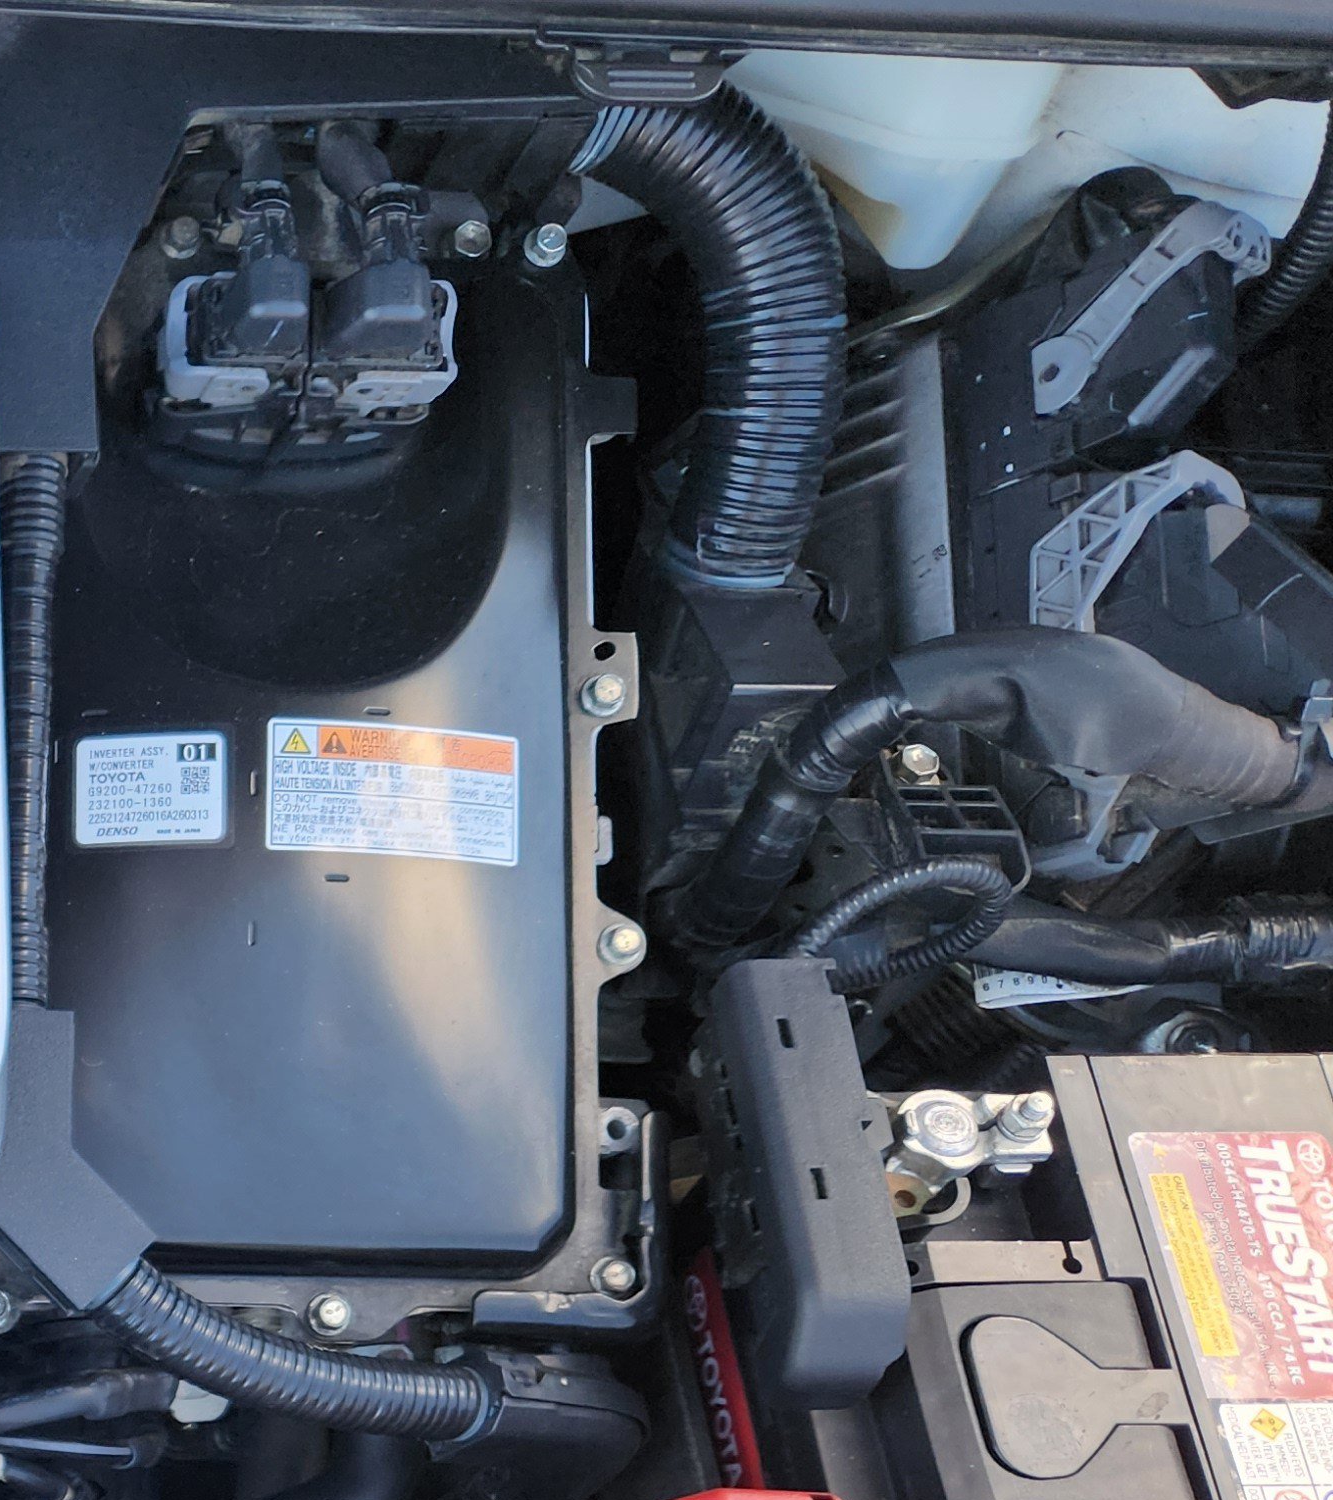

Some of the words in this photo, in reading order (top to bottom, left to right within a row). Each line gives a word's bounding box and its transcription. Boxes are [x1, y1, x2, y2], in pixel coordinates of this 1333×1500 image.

[89, 748, 134, 759] INVERTER
[140, 747, 169, 756] ASSY.
[183, 744, 208, 761] 01
[89, 760, 154, 771] W/CONVERTER
[274, 760, 293, 774] HIGH
[297, 761, 330, 775] VOLTAGE
[333, 762, 357, 777] INSIDE
[89, 772, 146, 784] TOYOTA
[274, 778, 299, 789] HAUTE
[301, 778, 332, 790] TENSION
[88, 783, 172, 797] G9200-47260
[275, 793, 290, 802] DO
[296, 794, 318, 802] NOT
[88, 797, 172, 811] 232100-1360
[96, 827, 138, 836] DENSO
[275, 823, 289, 832] NE
[295, 824, 315, 833] PAS
[1214, 1142, 1262, 1257] 00544-H4470-TS
[1266, 1301, 1287, 1330] CCA
[1279, 1344, 1298, 1362] 74
[1286, 1365, 1305, 1386] RC
[697, 1330, 743, 1487] TOYOTA
[1293, 1407, 1307, 1424] NESS
[1305, 1407, 1318, 1422] CAN
[1224, 1406, 1244, 1439] MEDICAL
[1310, 1424, 1326, 1446] CAUSE
[1282, 1433, 1299, 1457] FLUSH
[1291, 1459, 1305, 1477] EYES
[1255, 1463, 1268, 1478] GET
[1267, 1463, 1282, 1482] WITH
[1248, 1488, 1259, 1500] DO
